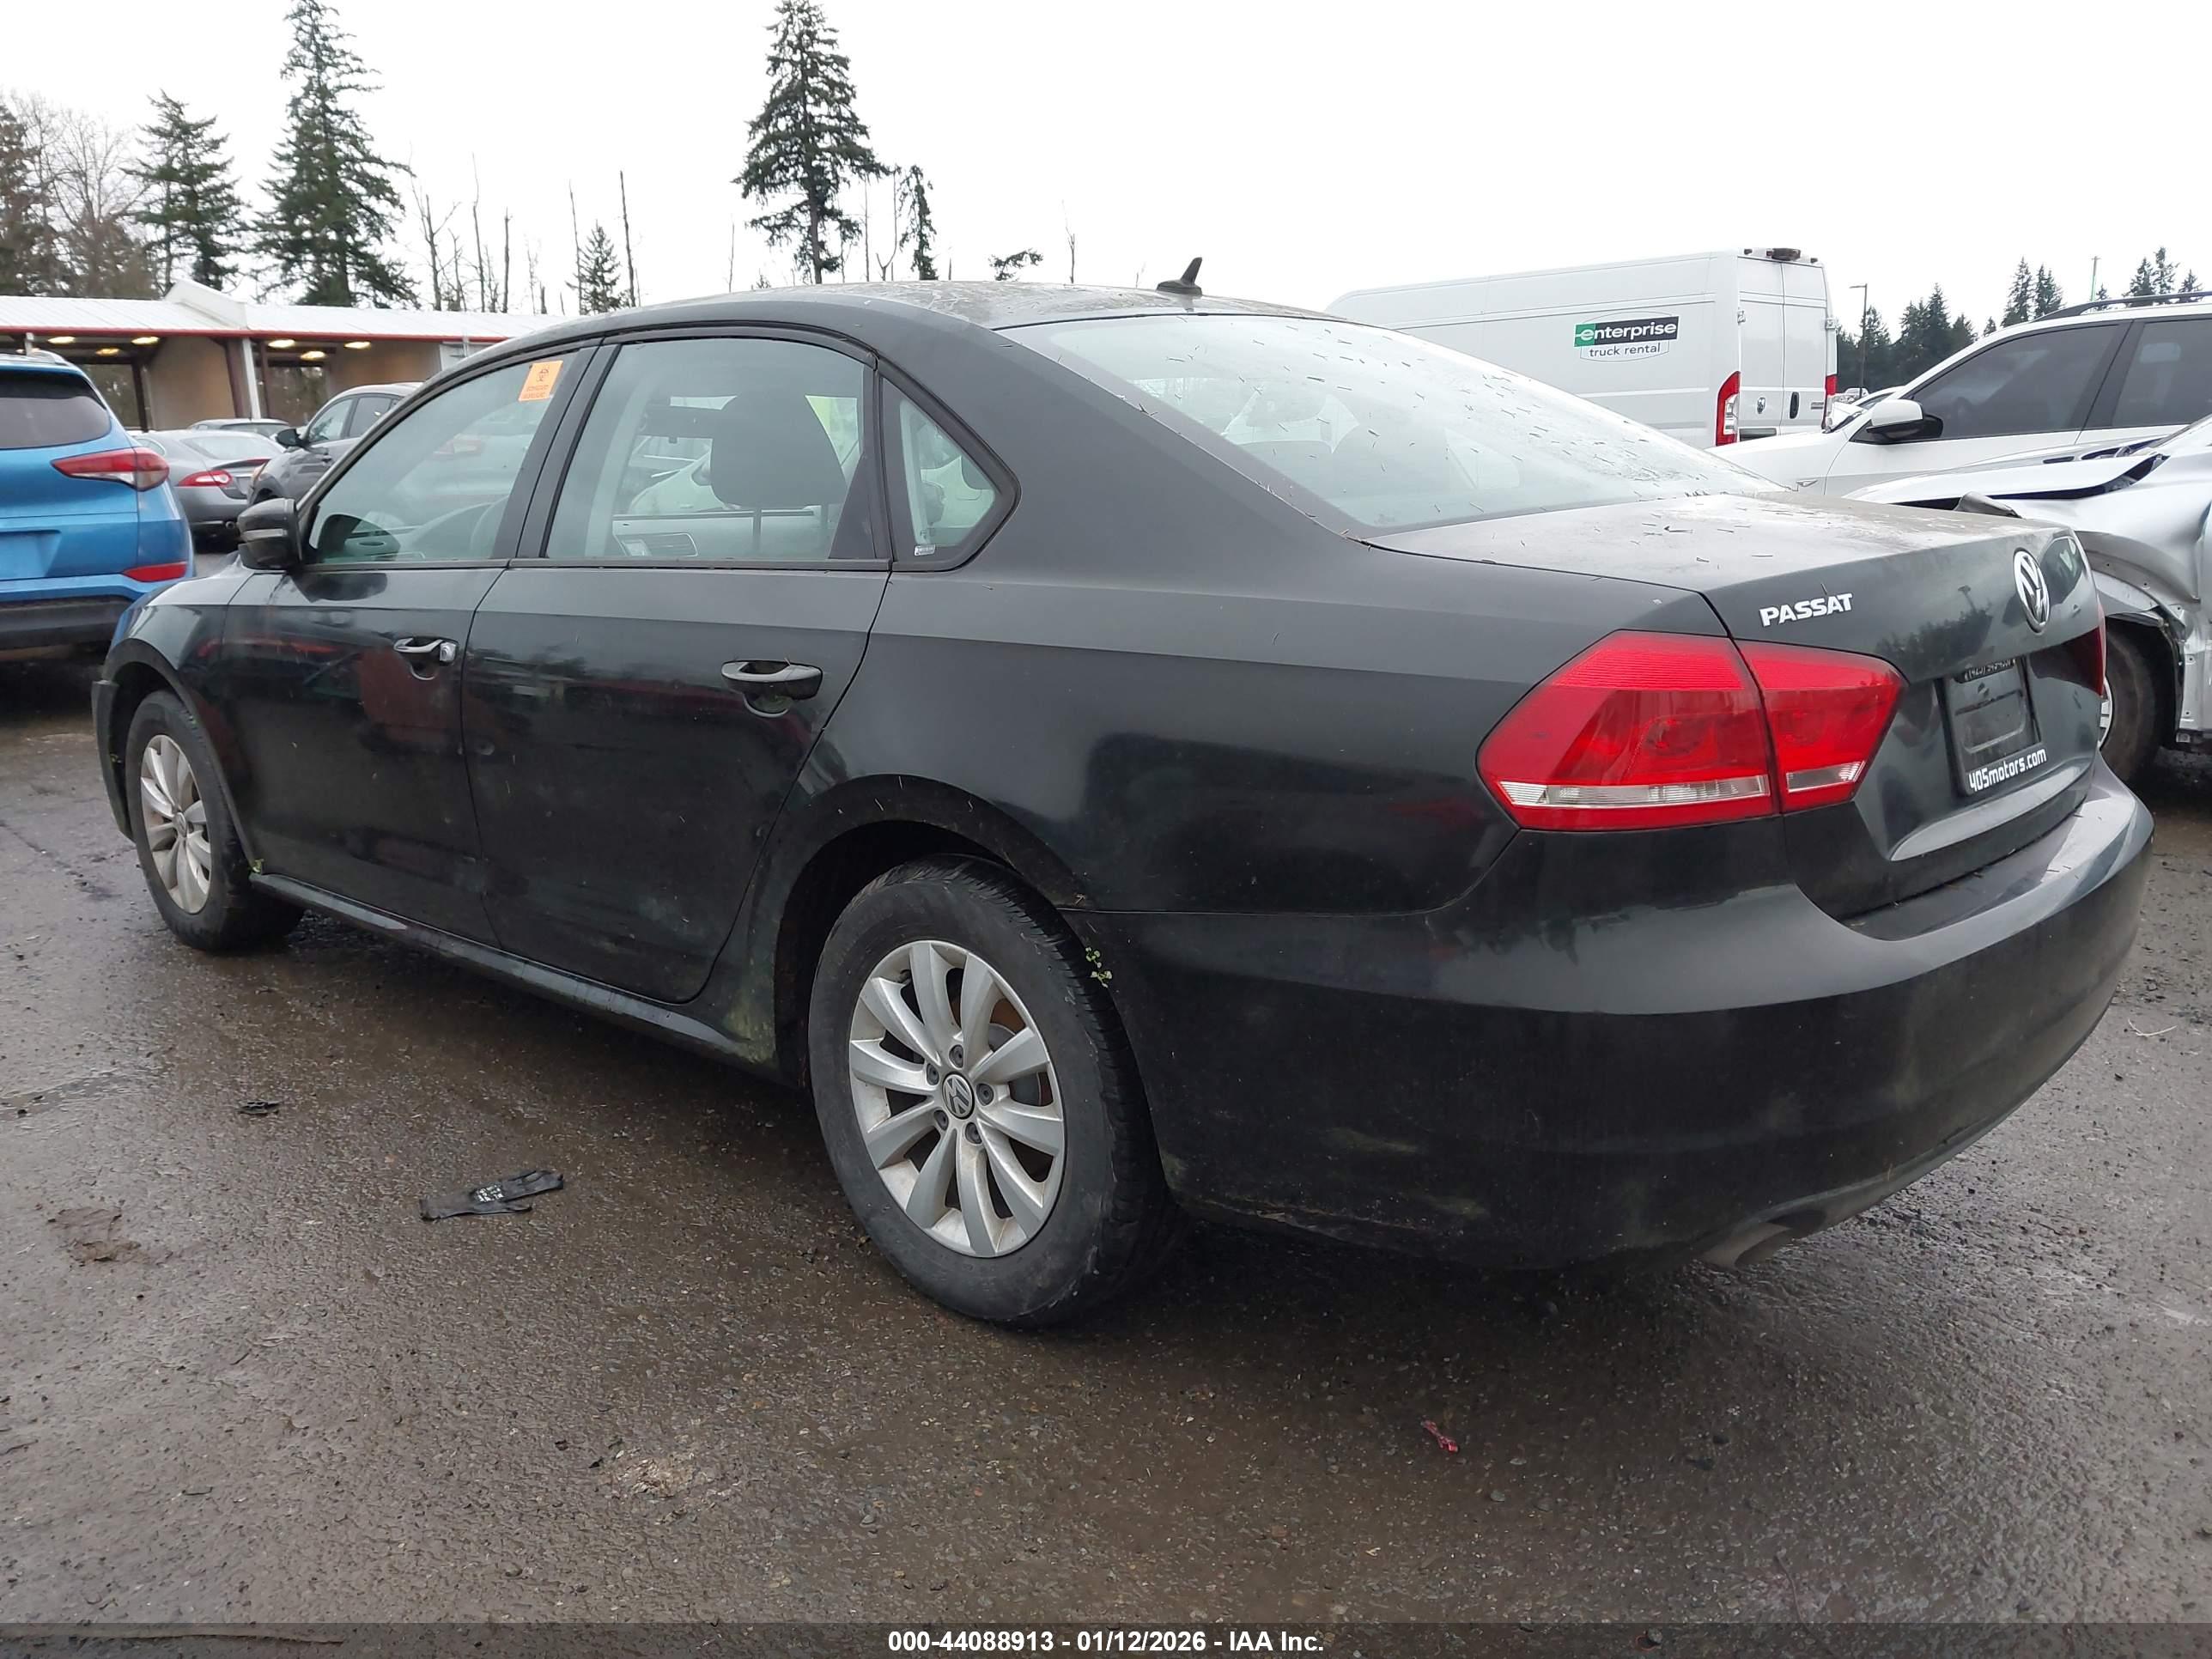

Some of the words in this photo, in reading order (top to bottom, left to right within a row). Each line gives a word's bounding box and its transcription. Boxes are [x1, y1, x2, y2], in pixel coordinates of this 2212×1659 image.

[1579, 321, 1677, 341] enterprise
[1589, 344, 1620, 357] truck
[1625, 342, 1661, 355] rental
[1759, 592, 1853, 627] PASSAT
[1968, 749, 2047, 792] 405motors.com
